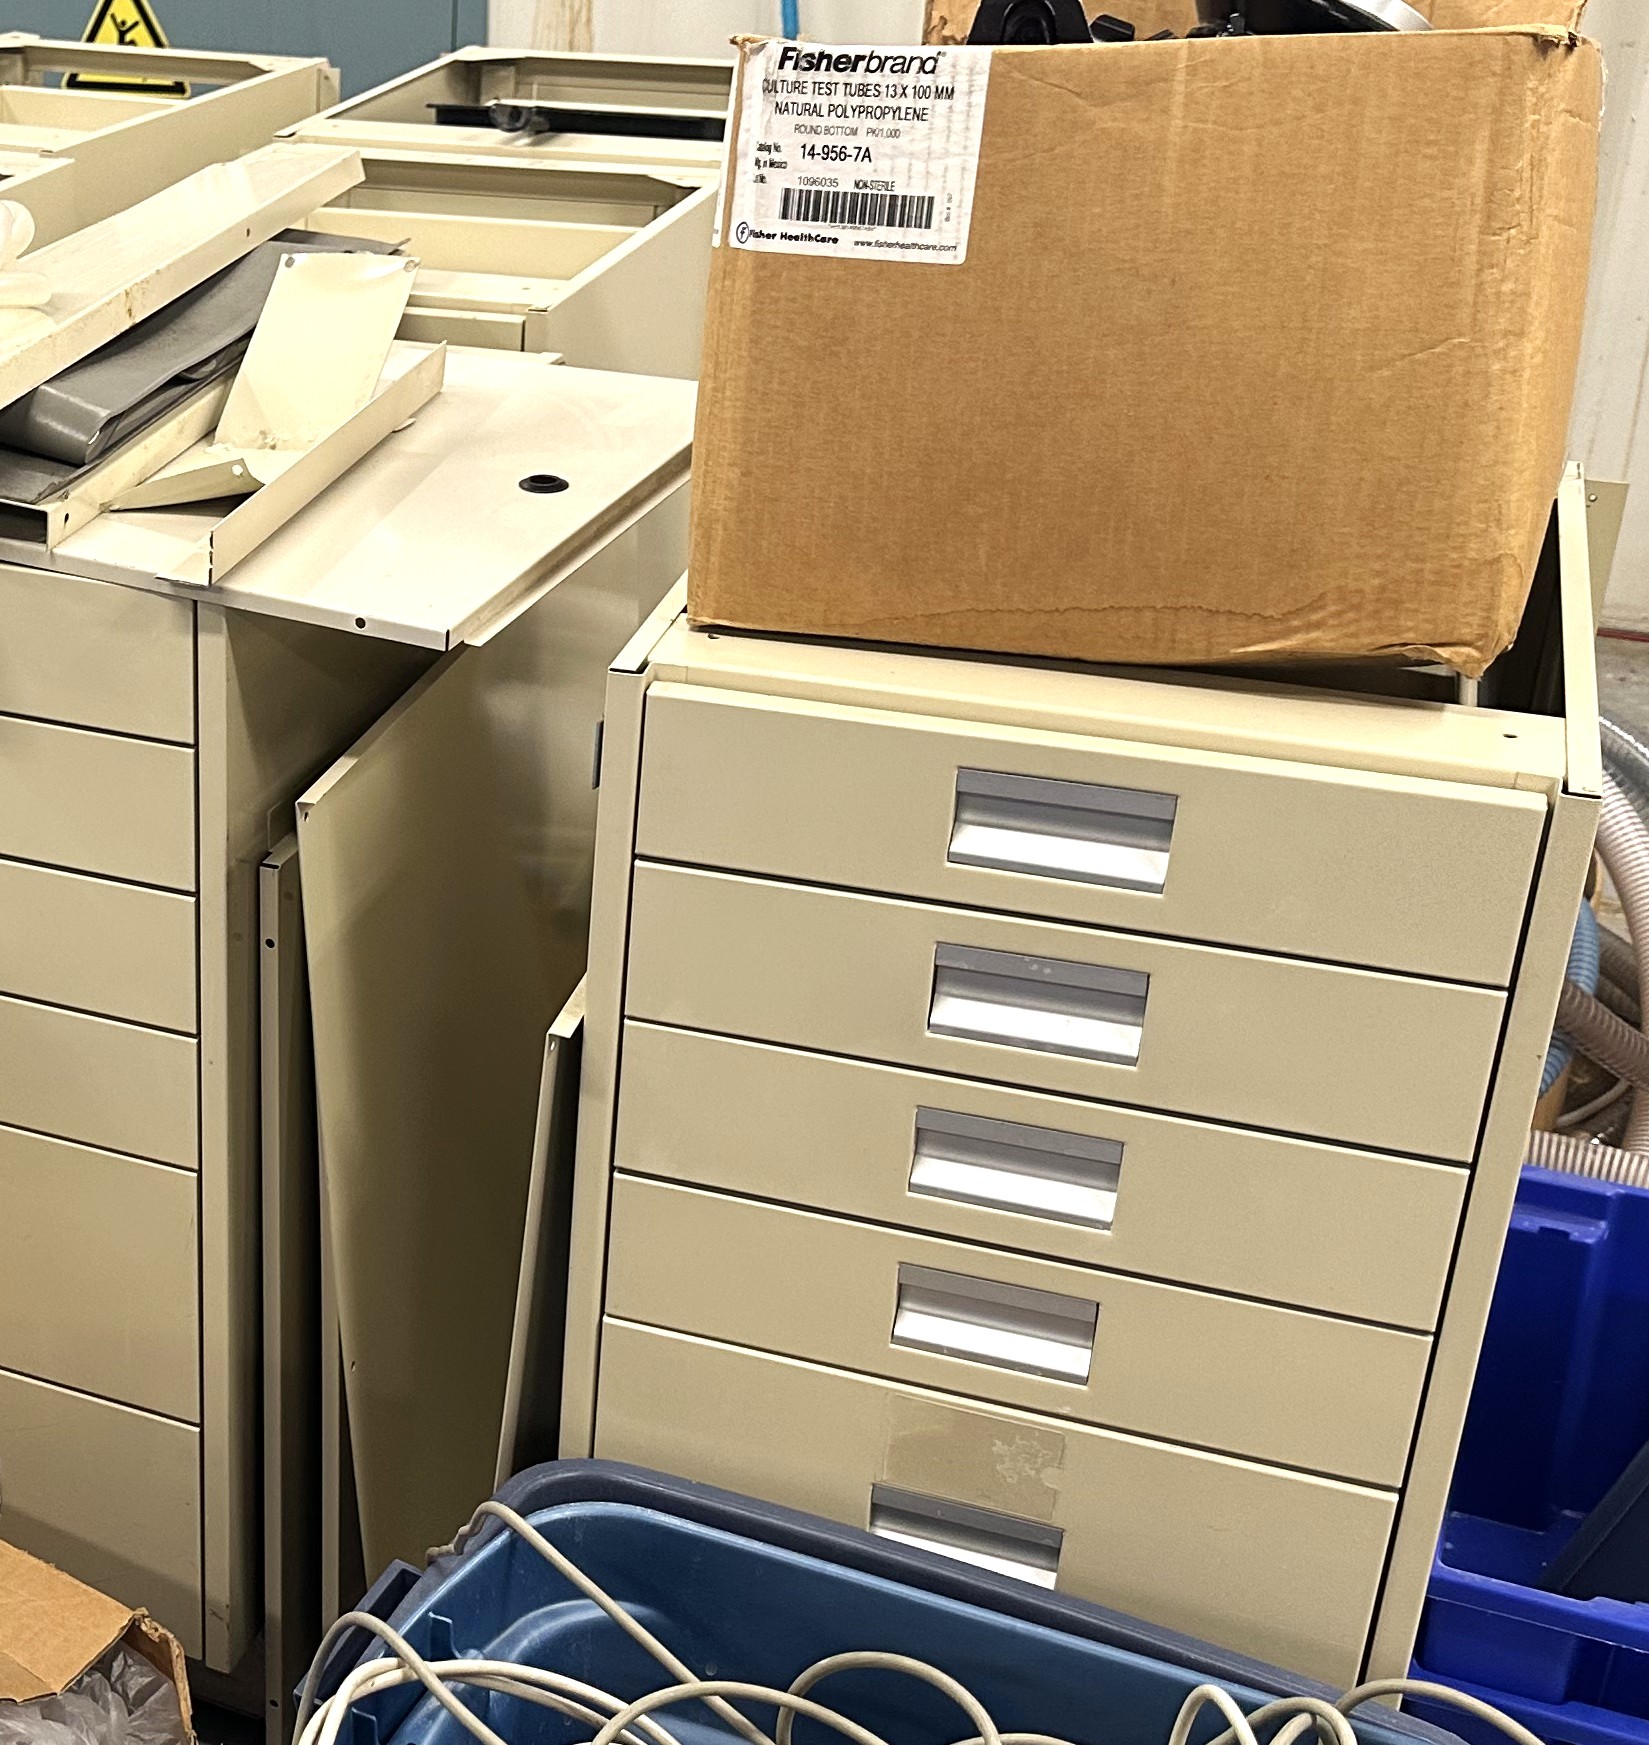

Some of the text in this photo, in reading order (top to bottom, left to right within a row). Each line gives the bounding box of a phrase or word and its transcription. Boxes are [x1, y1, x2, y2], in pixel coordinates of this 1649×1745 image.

[777, 46, 939, 75] Fisherbrand
[762, 79, 955, 100] CULTURE TEST TUBES 13 X 100 MM
[774, 101, 930, 122] NATURAL POLYPROPYLENE
[794, 123, 823, 136] ROUND
[823, 125, 859, 137] BOTTOM
[800, 143, 873, 163] 14-956-7A
[797, 175, 840, 189] 1096035
[779, 231, 840, 245] HealthCare
[853, 239, 958, 252] www.fisherhealthcare.com
